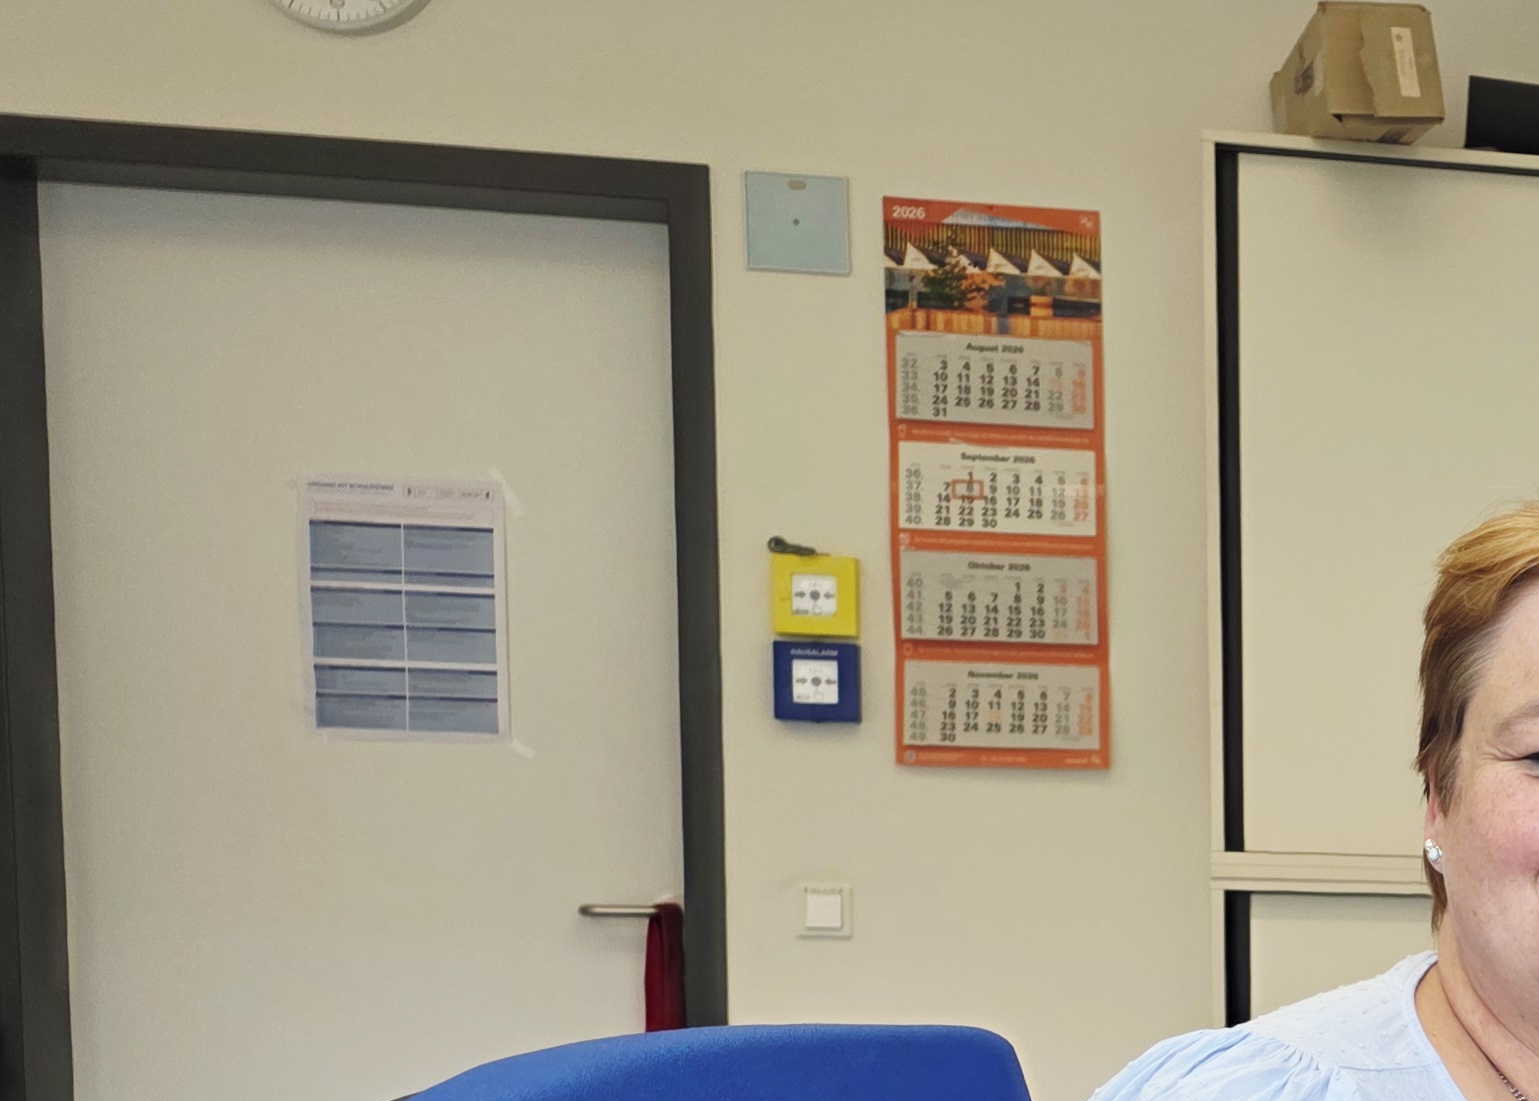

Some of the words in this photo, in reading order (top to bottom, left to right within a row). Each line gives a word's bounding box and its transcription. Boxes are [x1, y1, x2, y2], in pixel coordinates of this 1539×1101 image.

[892, 205, 925, 220] 2026
[965, 342, 999, 353] August
[939, 361, 948, 371] 3
[962, 362, 971, 372] 4
[986, 363, 994, 373] 5
[1009, 364, 1018, 375] 6
[1032, 365, 1040, 376] 7
[932, 372, 948, 382] 10
[956, 373, 971, 383] 11
[979, 375, 994, 385] 12
[1001, 376, 1018, 386] 13
[1025, 377, 1040, 387] 14
[932, 384, 948, 394] 17
[956, 385, 971, 395] 18
[979, 386, 994, 396] 19
[1001, 388, 1018, 398] 20
[1025, 389, 1040, 399] 21
[932, 395, 948, 405] 24
[956, 396, 971, 407] 25
[979, 398, 994, 408] 26
[1001, 399, 1018, 409] 27
[1025, 401, 1040, 411] 28
[932, 406, 948, 417] 31
[961, 452, 1010, 464] September
[966, 471, 974, 481] 1
[989, 472, 997, 482] 2
[1012, 473, 1020, 484] 3
[1035, 474, 1043, 485] 4
[943, 482, 951, 492] 7
[989, 484, 997, 494] 9
[1005, 485, 1020, 495] 10
[1027, 486, 1043, 496] 11
[935, 493, 951, 503] 14
[982, 495, 997, 506] 16
[1005, 497, 1020, 507] 17
[1027, 498, 1043, 508] 18
[935, 505, 951, 515] 21
[958, 506, 974, 516] 22
[982, 507, 997, 517] 23
[1005, 508, 1020, 518] 24
[1027, 509, 1043, 520] 25
[935, 516, 951, 526] 28
[958, 517, 974, 527] 29
[982, 518, 997, 528] 30
